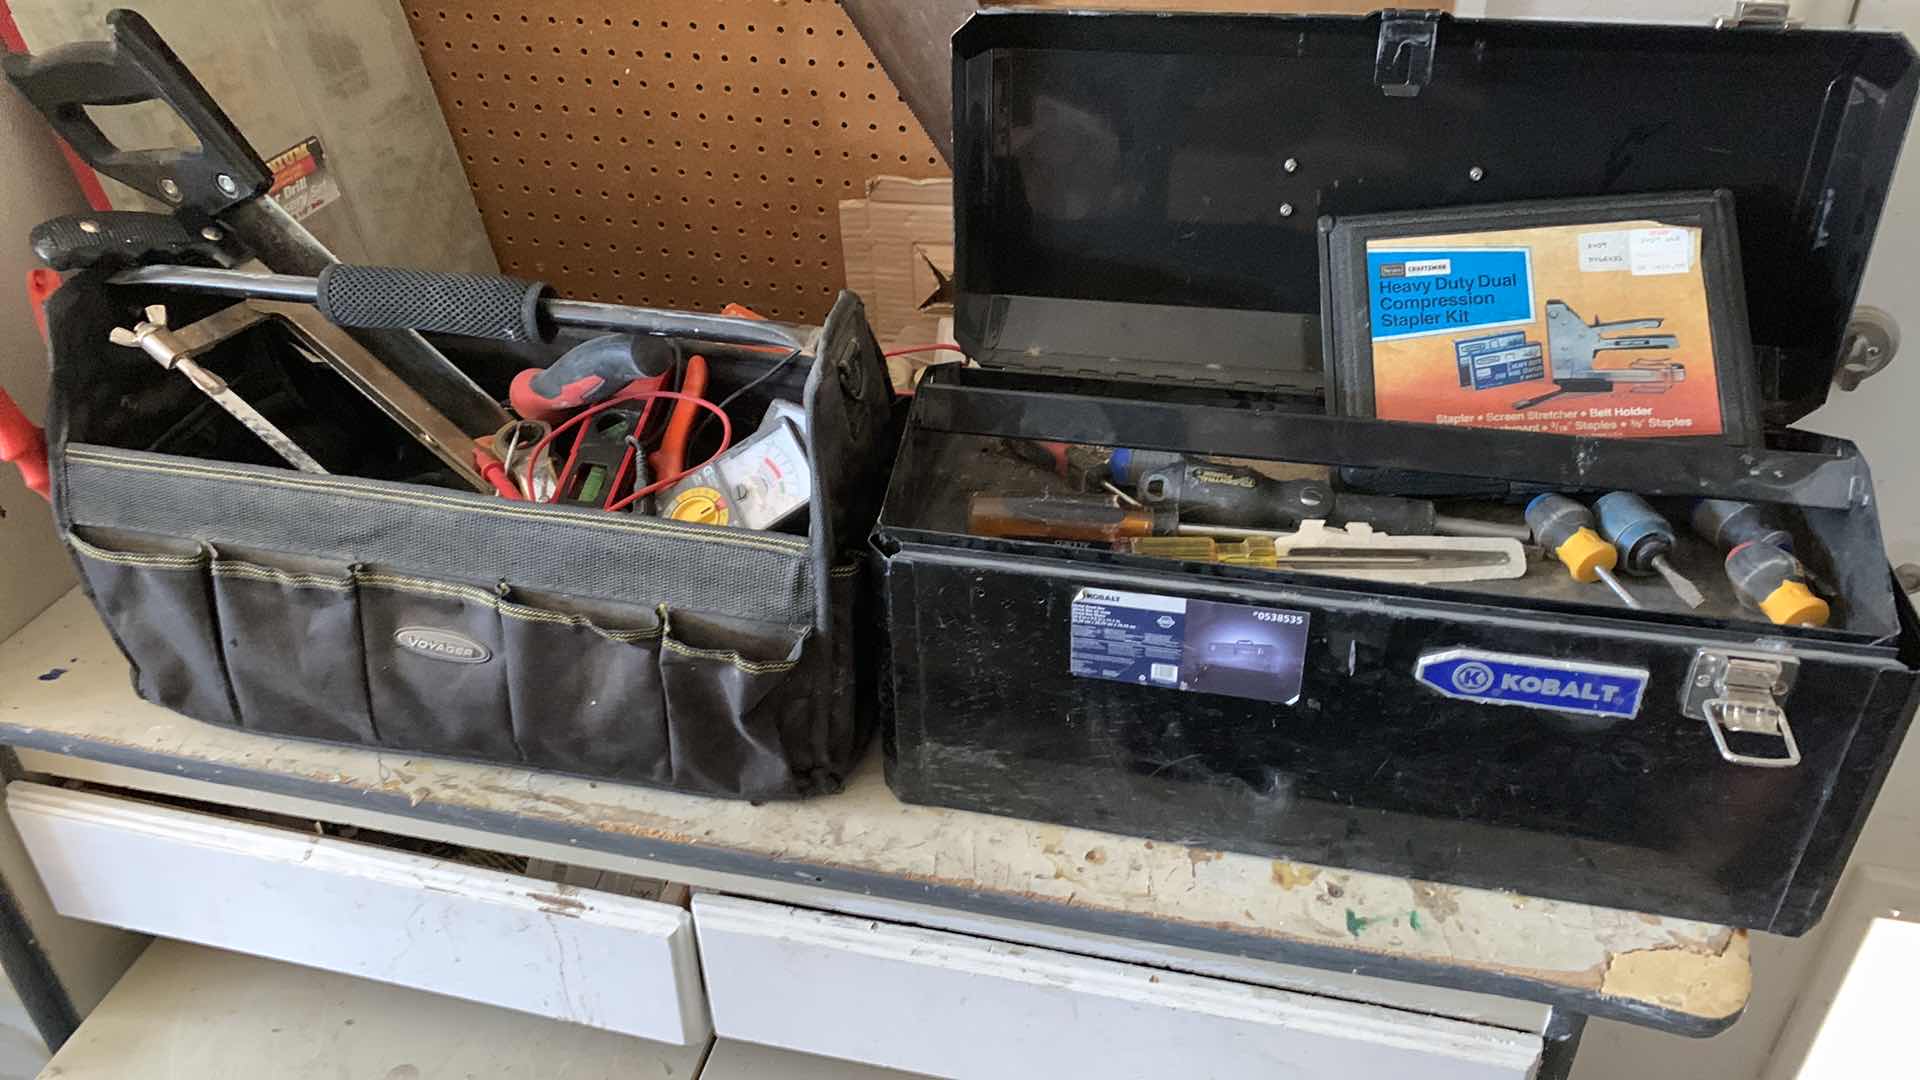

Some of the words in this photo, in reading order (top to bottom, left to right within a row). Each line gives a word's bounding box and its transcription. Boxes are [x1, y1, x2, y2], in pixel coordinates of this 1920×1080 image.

[283, 176, 306, 199] Drill
[1407, 263, 1447, 273] CRAFTSMAN
[1379, 280, 1431, 298] Heavy
[1436, 275, 1474, 292] Duty
[1479, 273, 1517, 288] Dual
[1380, 292, 1494, 311] Compression
[1381, 312, 1440, 329] Stapler
[1446, 310, 1470, 323] Kit
[1436, 413, 1474, 425] Stapler
[1486, 412, 1525, 422] Screen
[1527, 409, 1578, 420] Stretcher
[1589, 407, 1612, 418] Belt
[1614, 406, 1655, 417] Holder
[1576, 420, 1617, 432] Staples
[1648, 416, 1693, 429] Staples
[407, 634, 473, 657] VOYAGER
[1501, 673, 1620, 702] KOBALT
